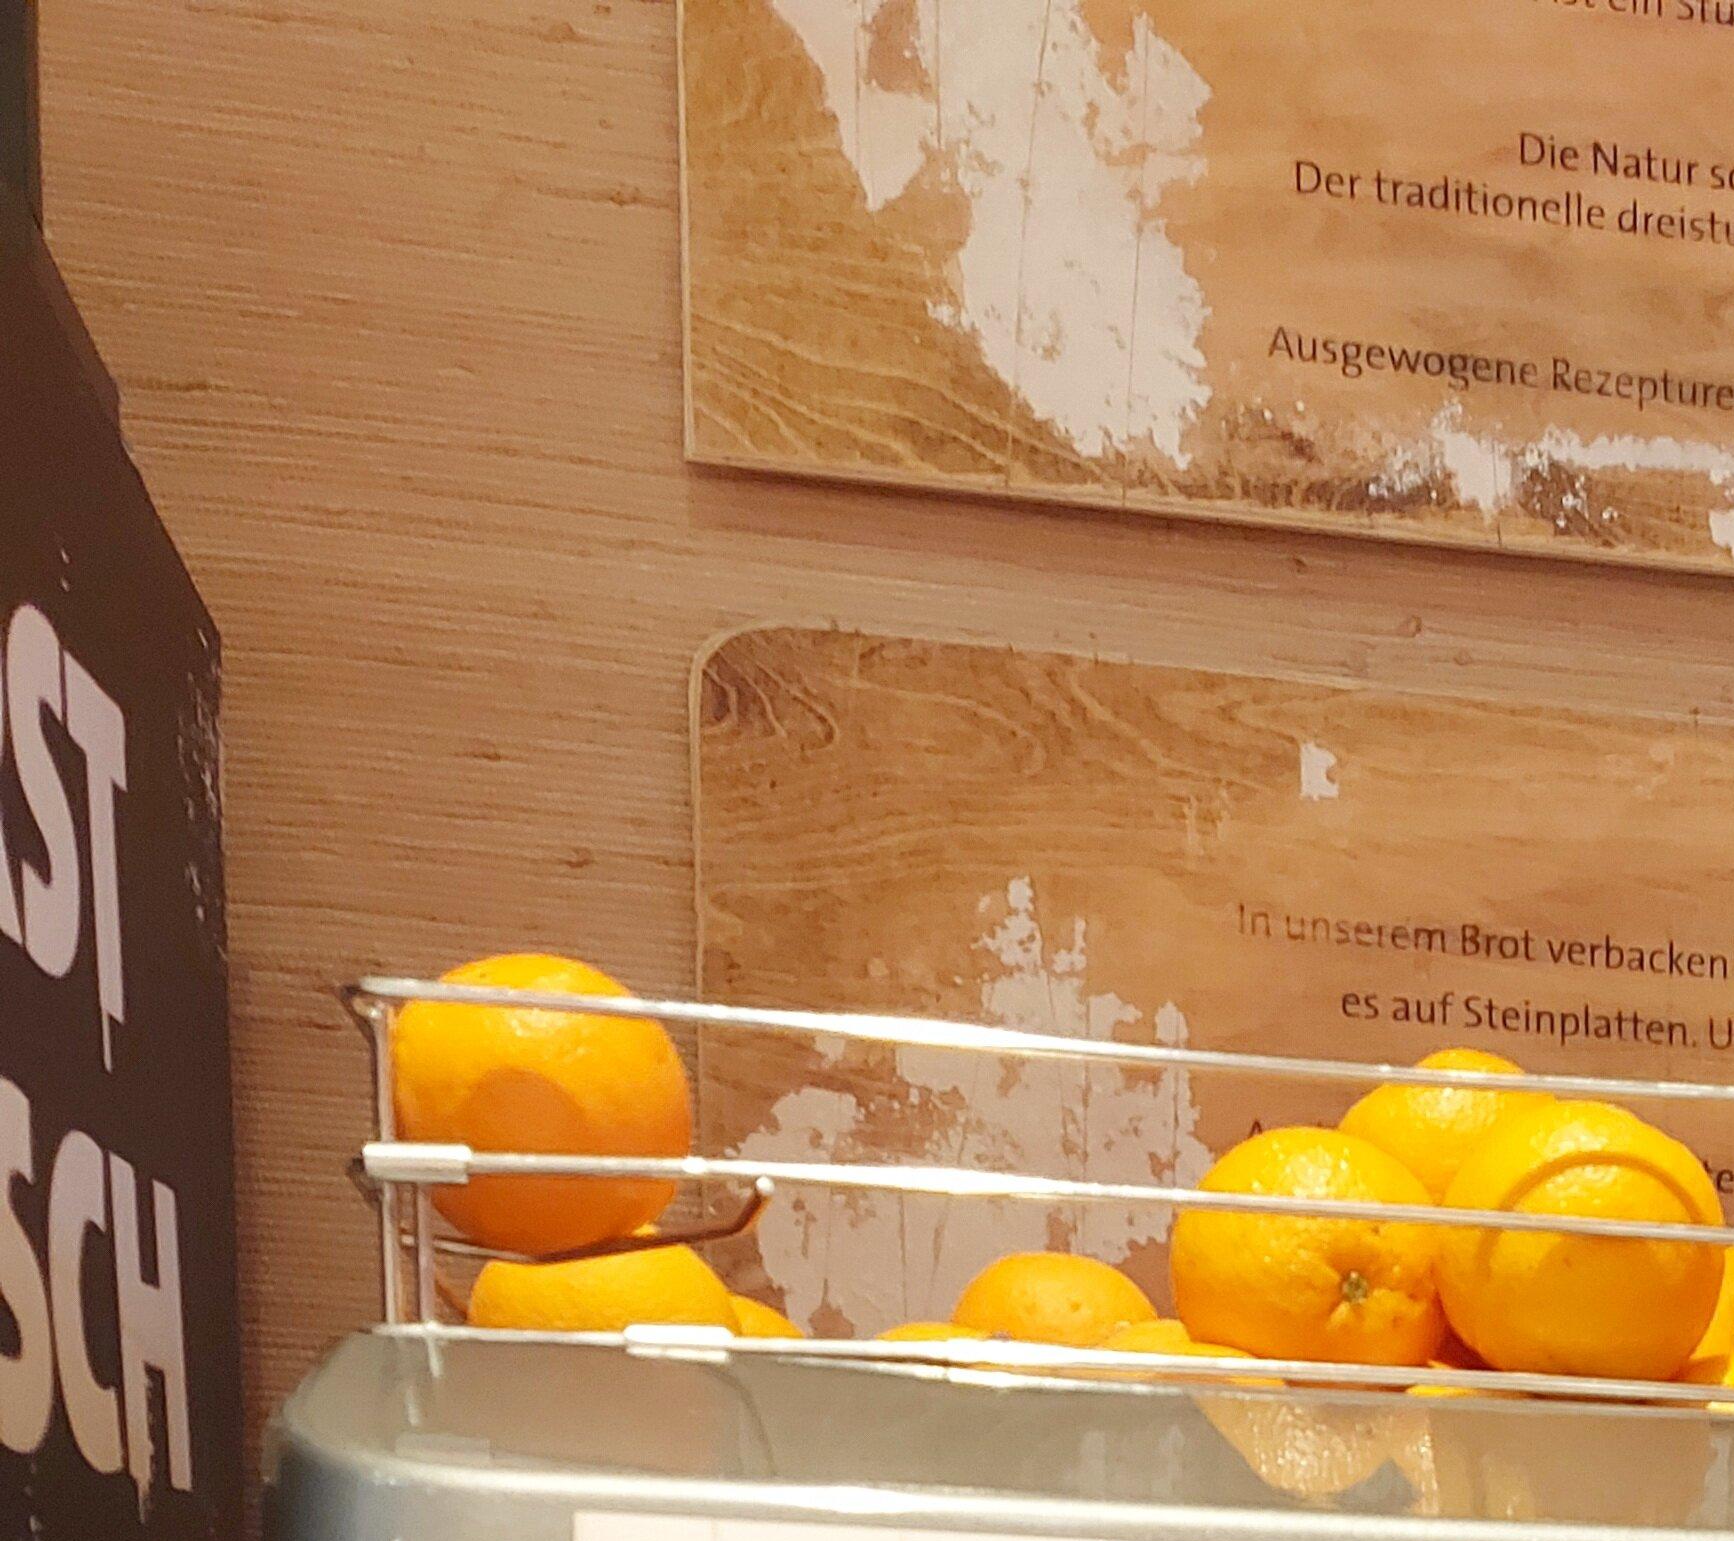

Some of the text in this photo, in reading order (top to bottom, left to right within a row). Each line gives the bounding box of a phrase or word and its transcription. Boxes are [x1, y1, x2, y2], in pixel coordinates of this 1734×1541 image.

[1519, 132, 1579, 172] Die
[1590, 140, 1699, 186] Natur
[1295, 160, 1362, 201] Der
[1373, 170, 1605, 230] traditionelle
[1268, 326, 1538, 391] Ausgewogene
[0, 602, 127, 1072] ST
[1285, 915, 1447, 953] unserem
[1461, 924, 1536, 962] Brot
[1547, 934, 1728, 980] verbacken
[1342, 993, 1379, 1019] es
[1392, 991, 1454, 1026] auf
[1463, 996, 1697, 1048] Steinplatten.
